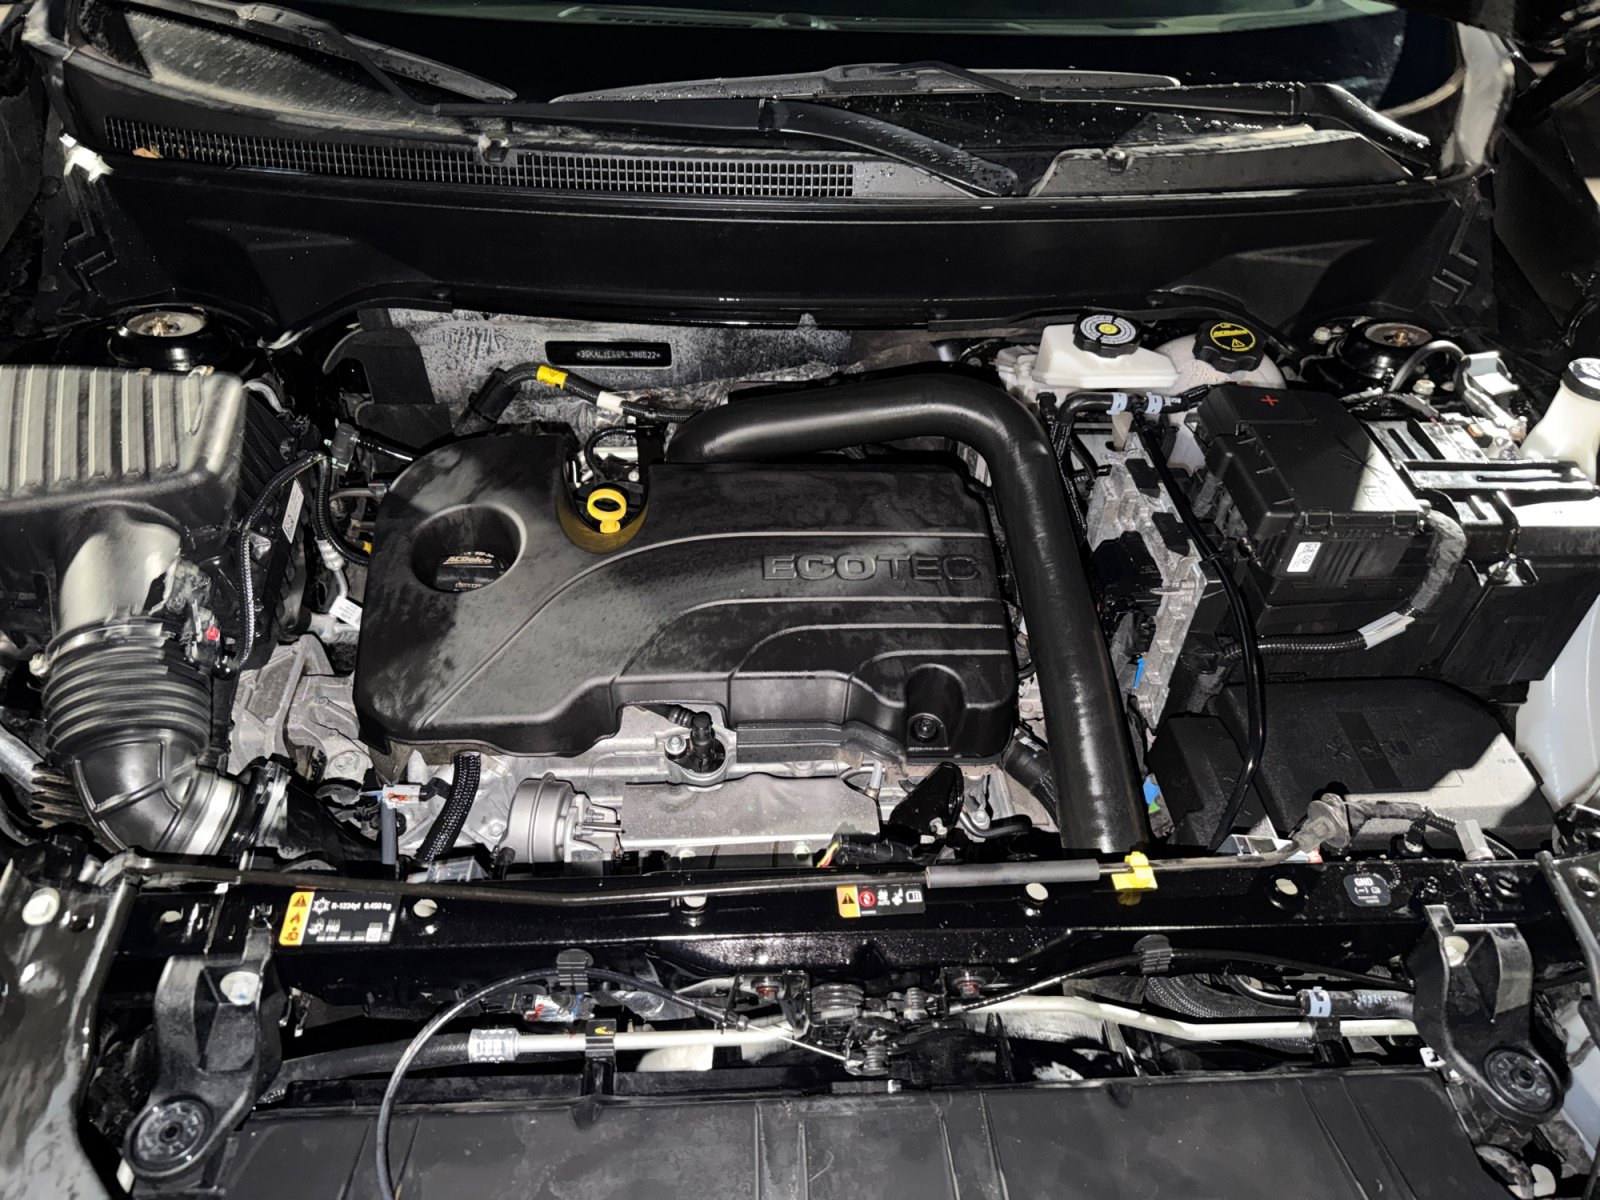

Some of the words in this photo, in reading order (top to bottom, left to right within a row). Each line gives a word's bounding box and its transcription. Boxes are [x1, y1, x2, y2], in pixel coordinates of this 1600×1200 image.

[443, 556, 493, 564] ACDelco
[763, 554, 979, 580] ECOTEC
[1354, 877, 1374, 887] GND
[331, 902, 361, 911] R-1234yf
[382, 902, 392, 911] kg
